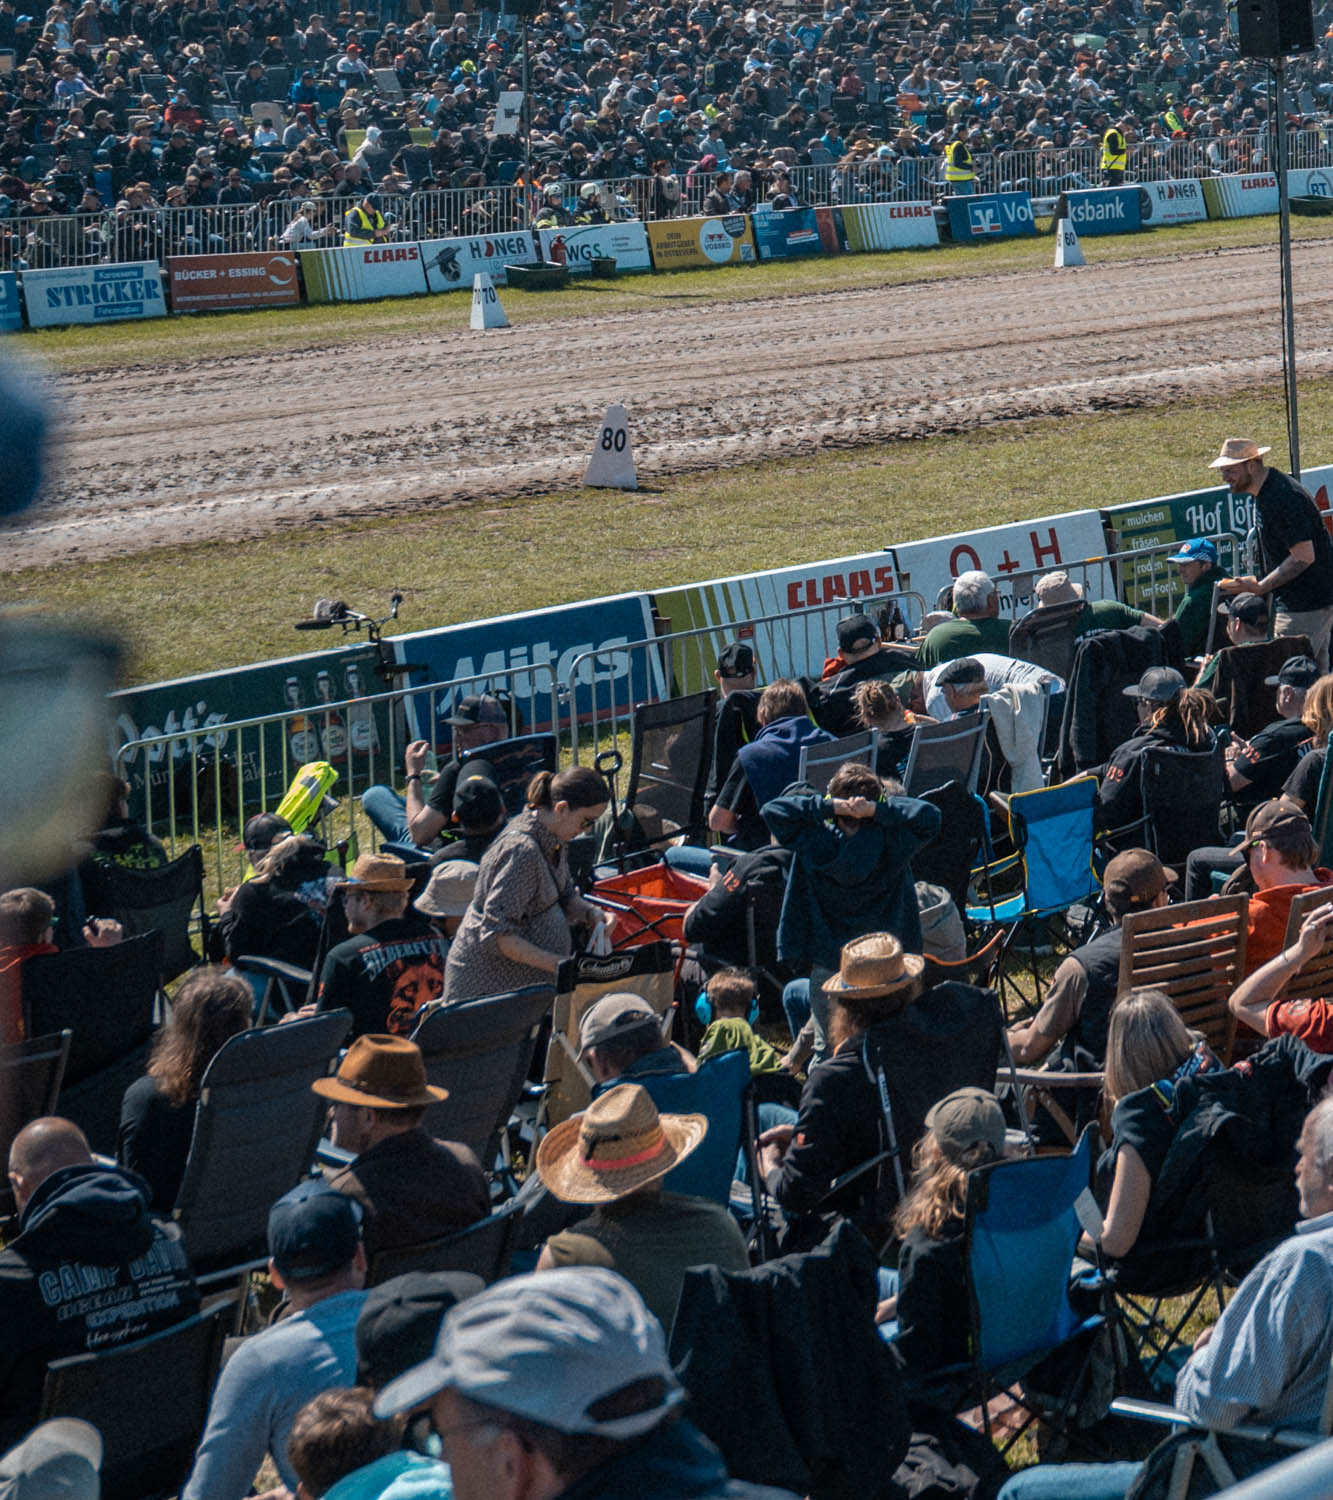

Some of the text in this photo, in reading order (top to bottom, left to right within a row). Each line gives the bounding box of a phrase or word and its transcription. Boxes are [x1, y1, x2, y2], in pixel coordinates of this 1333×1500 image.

[1241, 177, 1275, 190] CLAAS
[889, 205, 932, 219] CLAAS
[1003, 196, 1125, 222] Vol ksbank
[1064, 231, 1076, 246] 60
[363, 246, 419, 264] CLAAS
[567, 243, 601, 262] WGS
[174, 269, 216, 281] BÜCKER
[228, 267, 267, 279] ESSING
[46, 278, 161, 308] STRICKER
[482, 287, 496, 304] 70
[601, 427, 626, 452] 80
[1126, 509, 1165, 529] mulchen
[1186, 501, 1222, 534] Hof
[1030, 527, 1063, 568] H
[1131, 534, 1160, 550] fräsen
[787, 566, 894, 610] CLAAS
[436, 636, 633, 716] Mitas
[360, 936, 448, 982] SILBERFU
